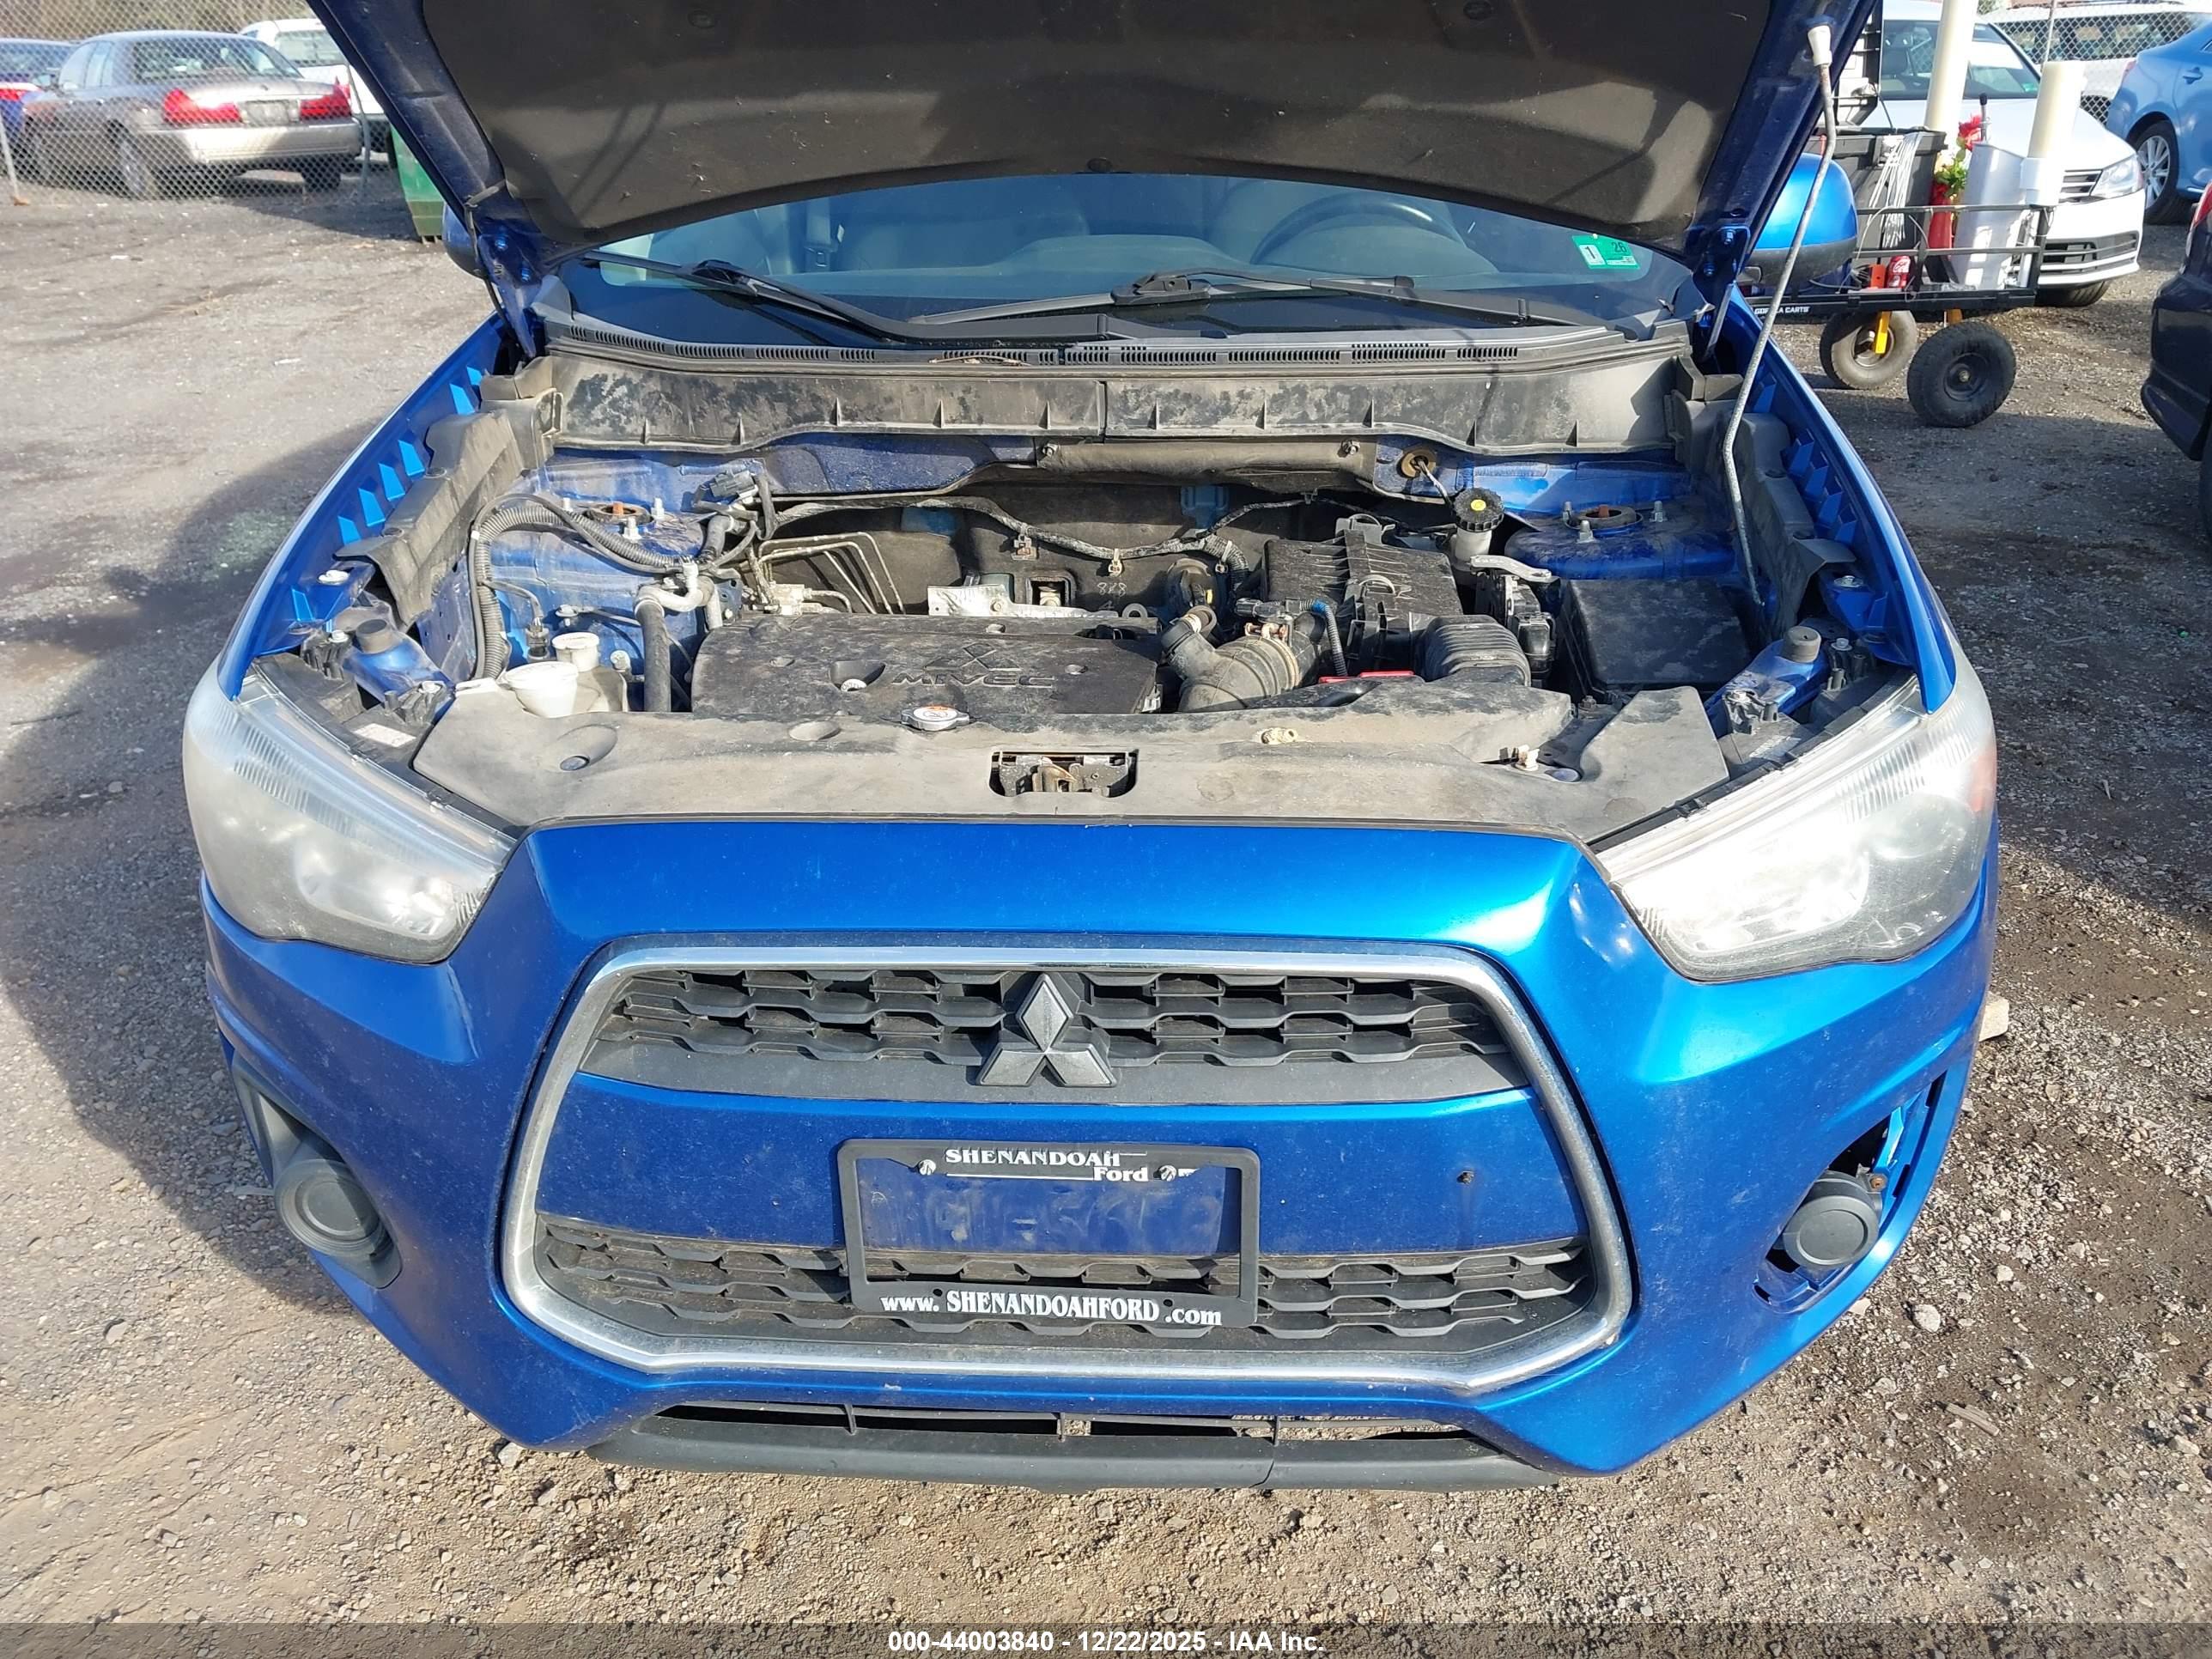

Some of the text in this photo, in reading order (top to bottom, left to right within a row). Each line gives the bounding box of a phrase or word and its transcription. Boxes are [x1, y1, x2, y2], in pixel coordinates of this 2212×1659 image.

[1584, 246, 1595, 259] 1
[1611, 241, 1627, 253] 26
[891, 672, 1055, 688] MIVEC
[945, 1148, 1121, 1167] SHENANDOAH
[1092, 1166, 1149, 1182] Ford
[880, 1290, 1223, 1326] www. SHENANDOAHFORD .com
